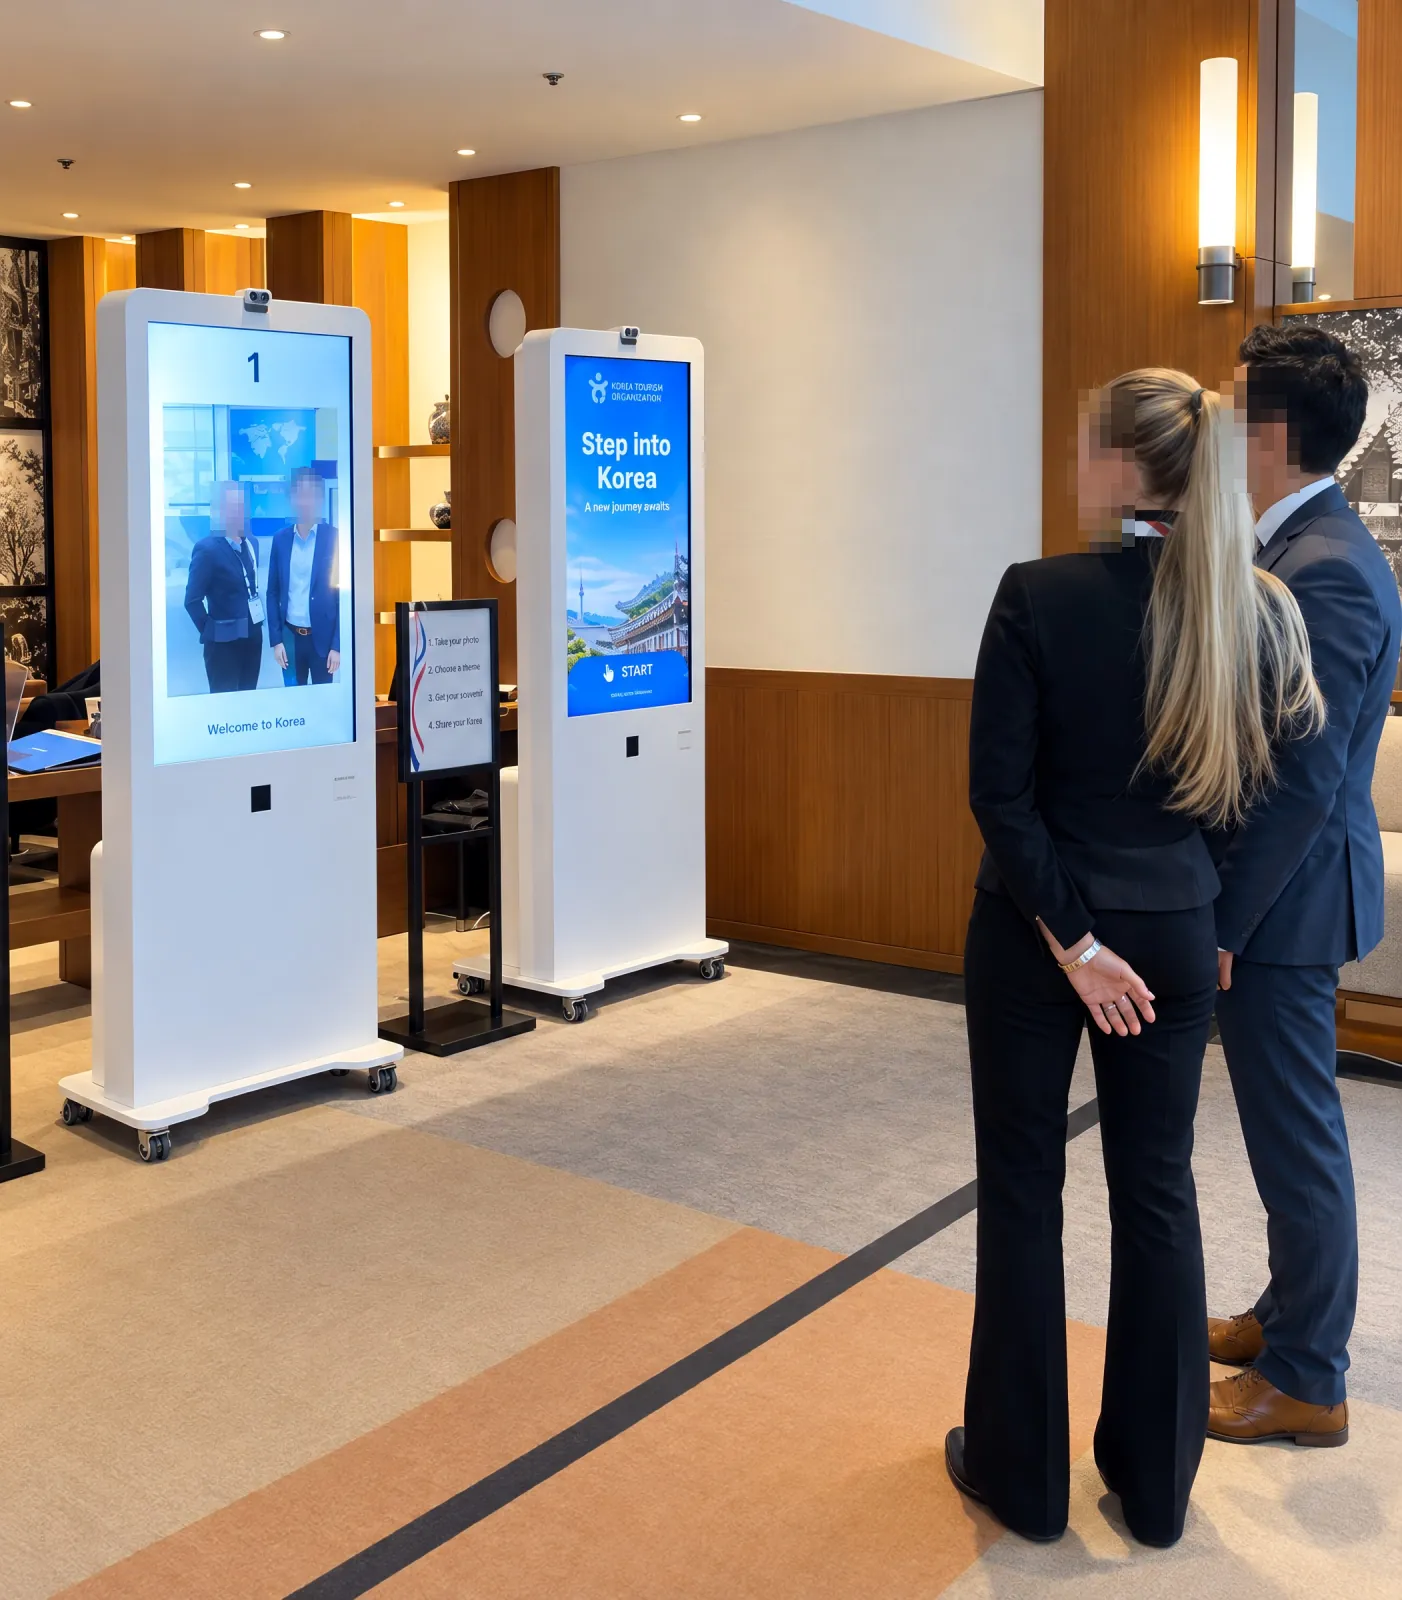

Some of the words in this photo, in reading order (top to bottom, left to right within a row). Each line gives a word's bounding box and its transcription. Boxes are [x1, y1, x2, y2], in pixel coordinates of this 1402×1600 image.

[247, 351, 260, 383] 1
[581, 431, 628, 461] Step
[633, 431, 671, 456] into
[597, 465, 657, 489] Korea
[584, 502, 592, 513] A
[593, 503, 610, 512] new
[611, 501, 643, 514] journey
[643, 501, 670, 511] awaits
[428, 638, 434, 647] 1.
[435, 637, 449, 647] Take
[449, 638, 462, 647] your
[462, 636, 480, 646] photo
[434, 665, 457, 674] Choose
[462, 663, 481, 672] theme
[621, 663, 654, 678] START
[428, 694, 434, 702] 3.
[435, 693, 446, 702] Get
[446, 692, 459, 702] your
[207, 722, 259, 735] Welcome
[261, 719, 273, 730] to
[275, 716, 306, 729] Korea
[428, 721, 435, 730] 4.
[435, 719, 453, 729] Share
[453, 718, 466, 728] your
[466, 717, 483, 726] Korea
